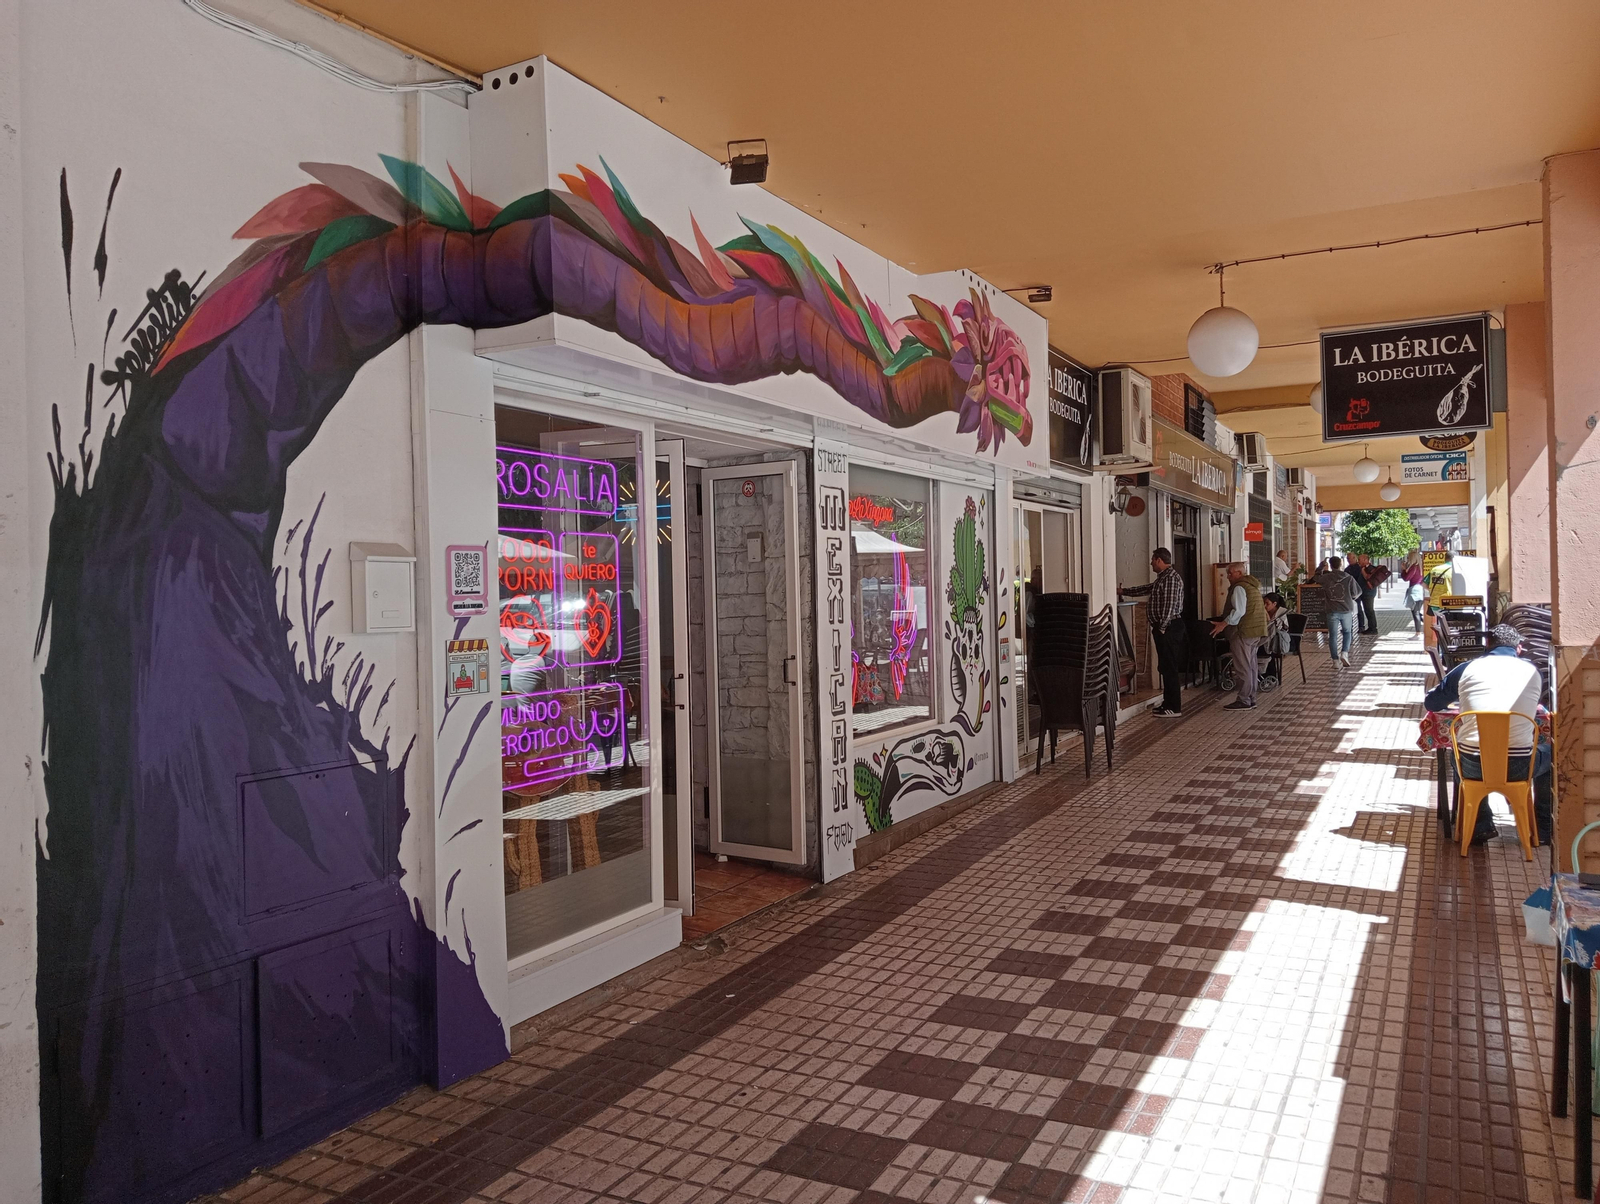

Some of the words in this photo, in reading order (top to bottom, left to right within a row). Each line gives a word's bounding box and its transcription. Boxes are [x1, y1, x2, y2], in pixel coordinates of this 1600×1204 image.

[1333, 345, 1366, 367] LA
[1370, 333, 1478, 363] IBÉRICA
[1048, 364, 1053, 389] A
[1054, 367, 1087, 405] IBÉRICA
[1356, 362, 1457, 384] BODEGUITA
[1049, 397, 1081, 424] BODEGUITA
[1333, 420, 1381, 431] Cruzcampo
[817, 448, 848, 473] STREET
[502, 537, 552, 564] OOD
[582, 541, 597, 558] te
[563, 563, 616, 581] QUIERO
[819, 484, 849, 813] MEXICAN
[826, 821, 853, 855] FOOD
